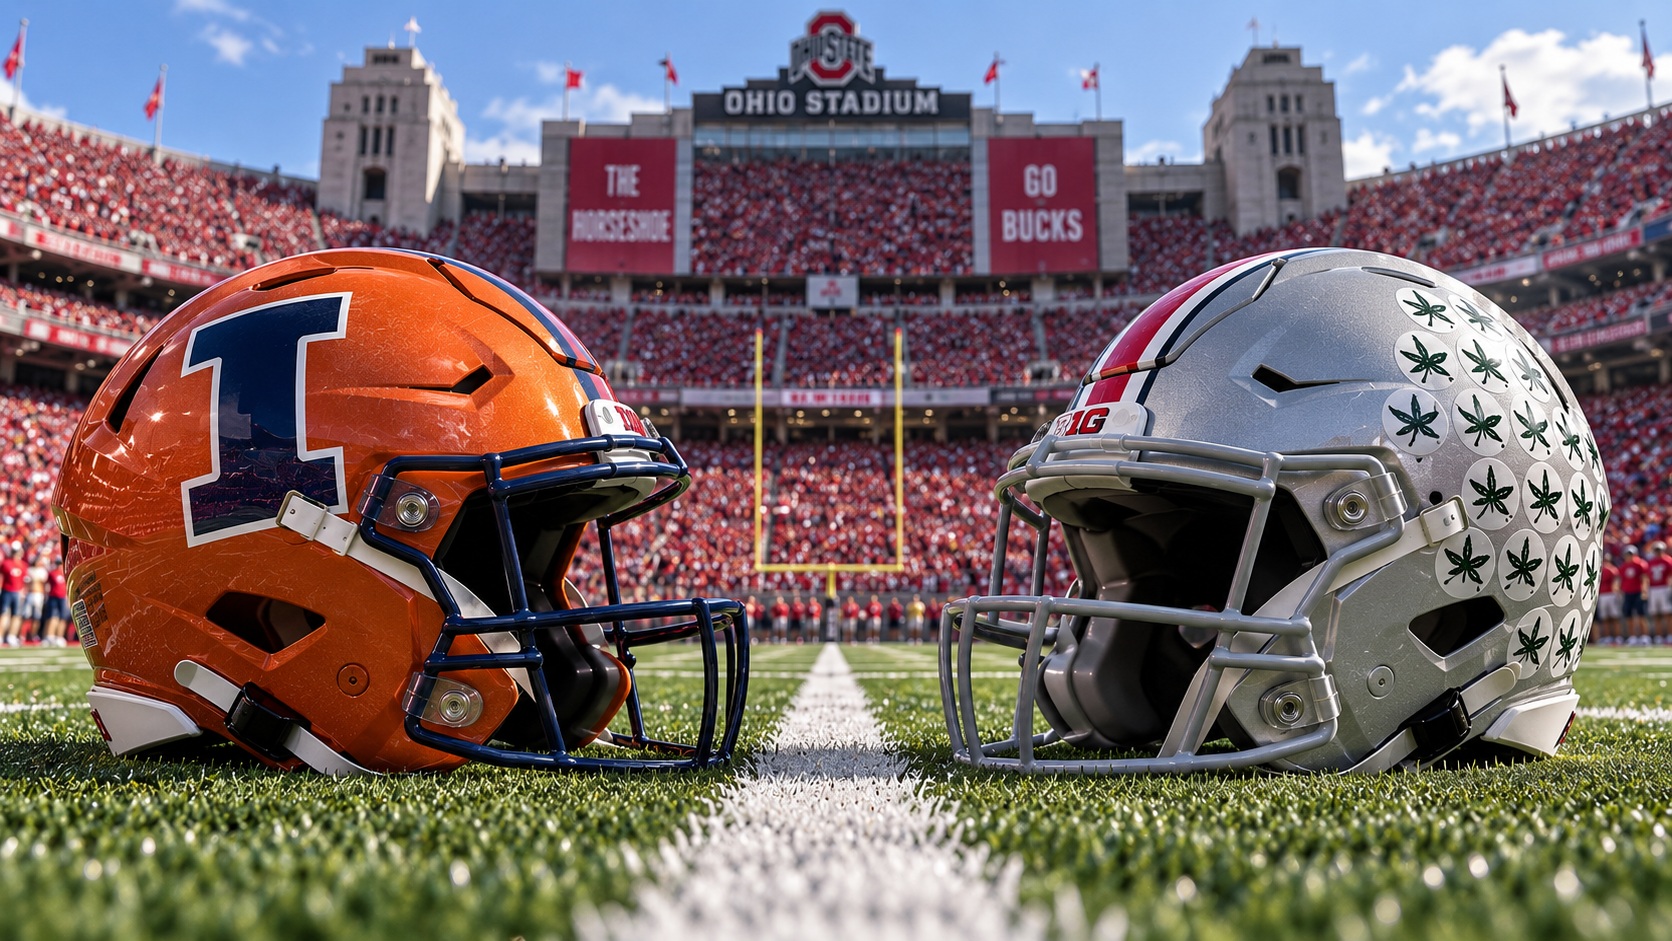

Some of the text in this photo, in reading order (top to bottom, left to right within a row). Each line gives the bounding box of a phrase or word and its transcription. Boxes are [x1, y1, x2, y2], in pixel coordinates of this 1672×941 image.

[724, 90, 939, 115] OHIO STADIUM
[604, 164, 640, 197] THE
[1023, 163, 1057, 198] GO
[572, 209, 671, 242] HORSESHOE
[1002, 208, 1083, 242] BUCKS
